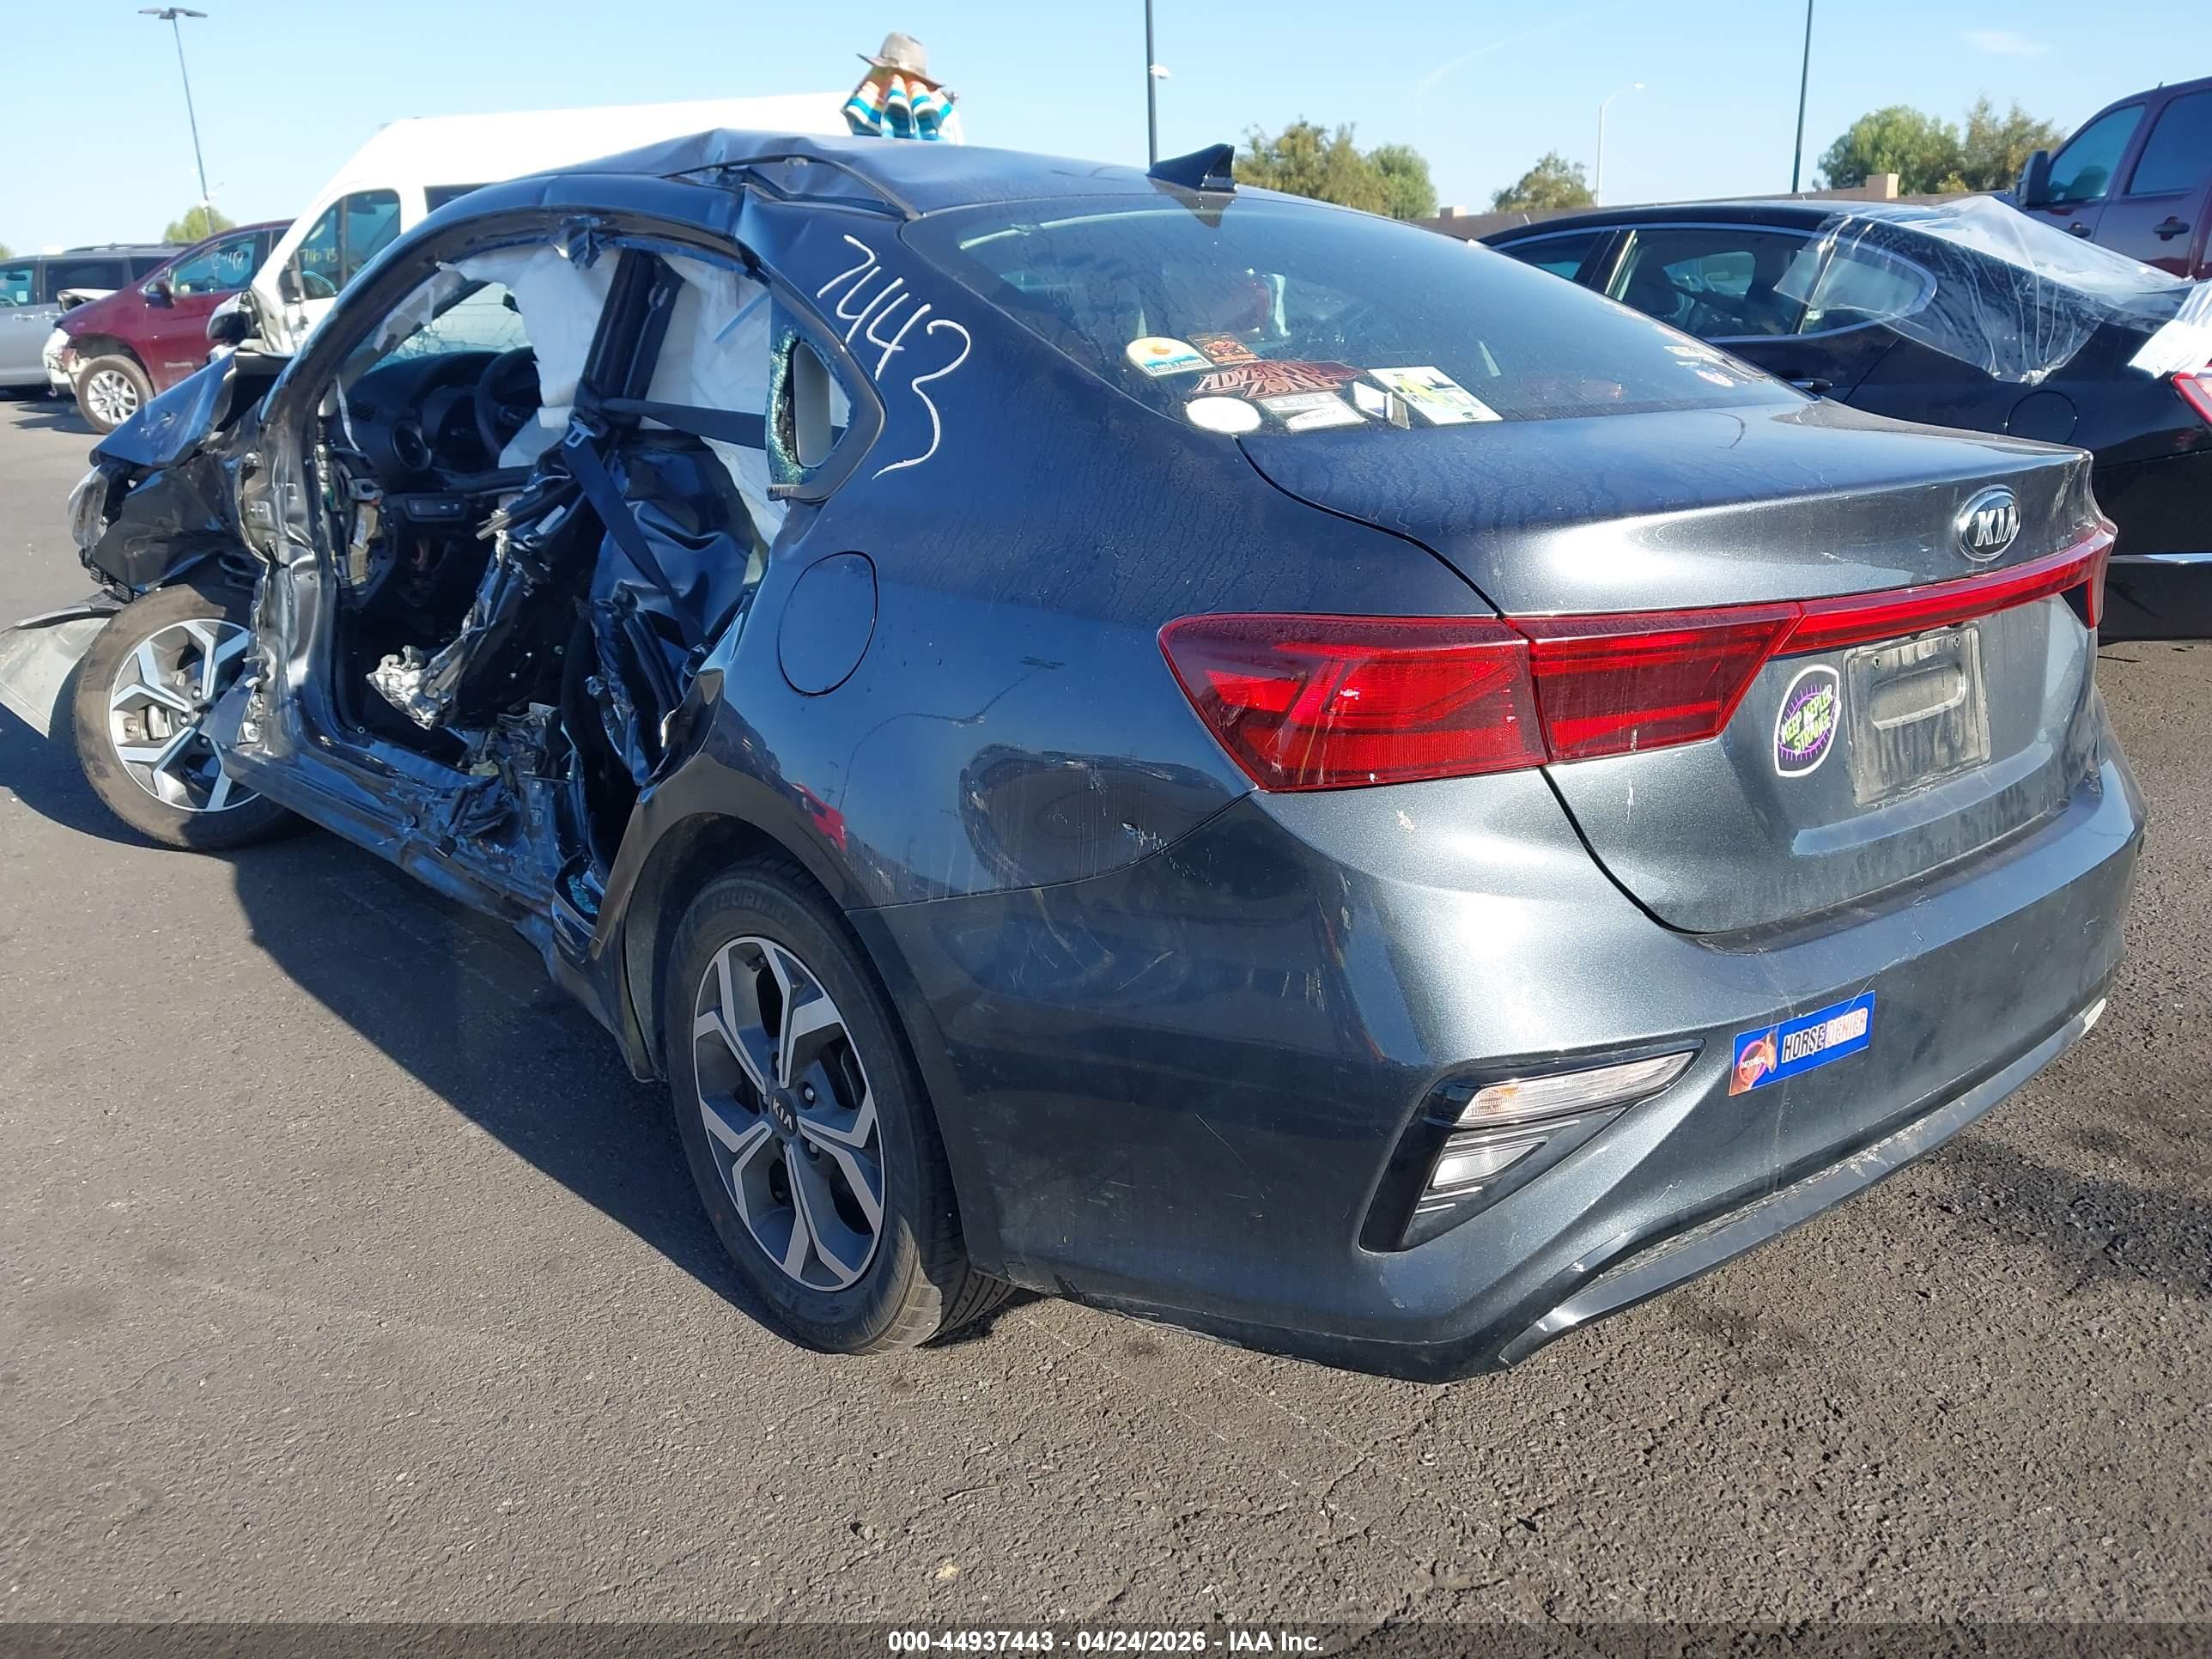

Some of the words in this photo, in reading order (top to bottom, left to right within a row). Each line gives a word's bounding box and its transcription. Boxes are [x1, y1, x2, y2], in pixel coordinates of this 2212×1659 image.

[817, 234, 971, 480] 7443
[1975, 506, 2016, 546] KIA
[1781, 711, 1802, 745] KEEP
[1793, 708, 1832, 756] STRANGE
[1782, 1024, 1826, 1064] HORSE
[774, 1098, 793, 1130] KIA
